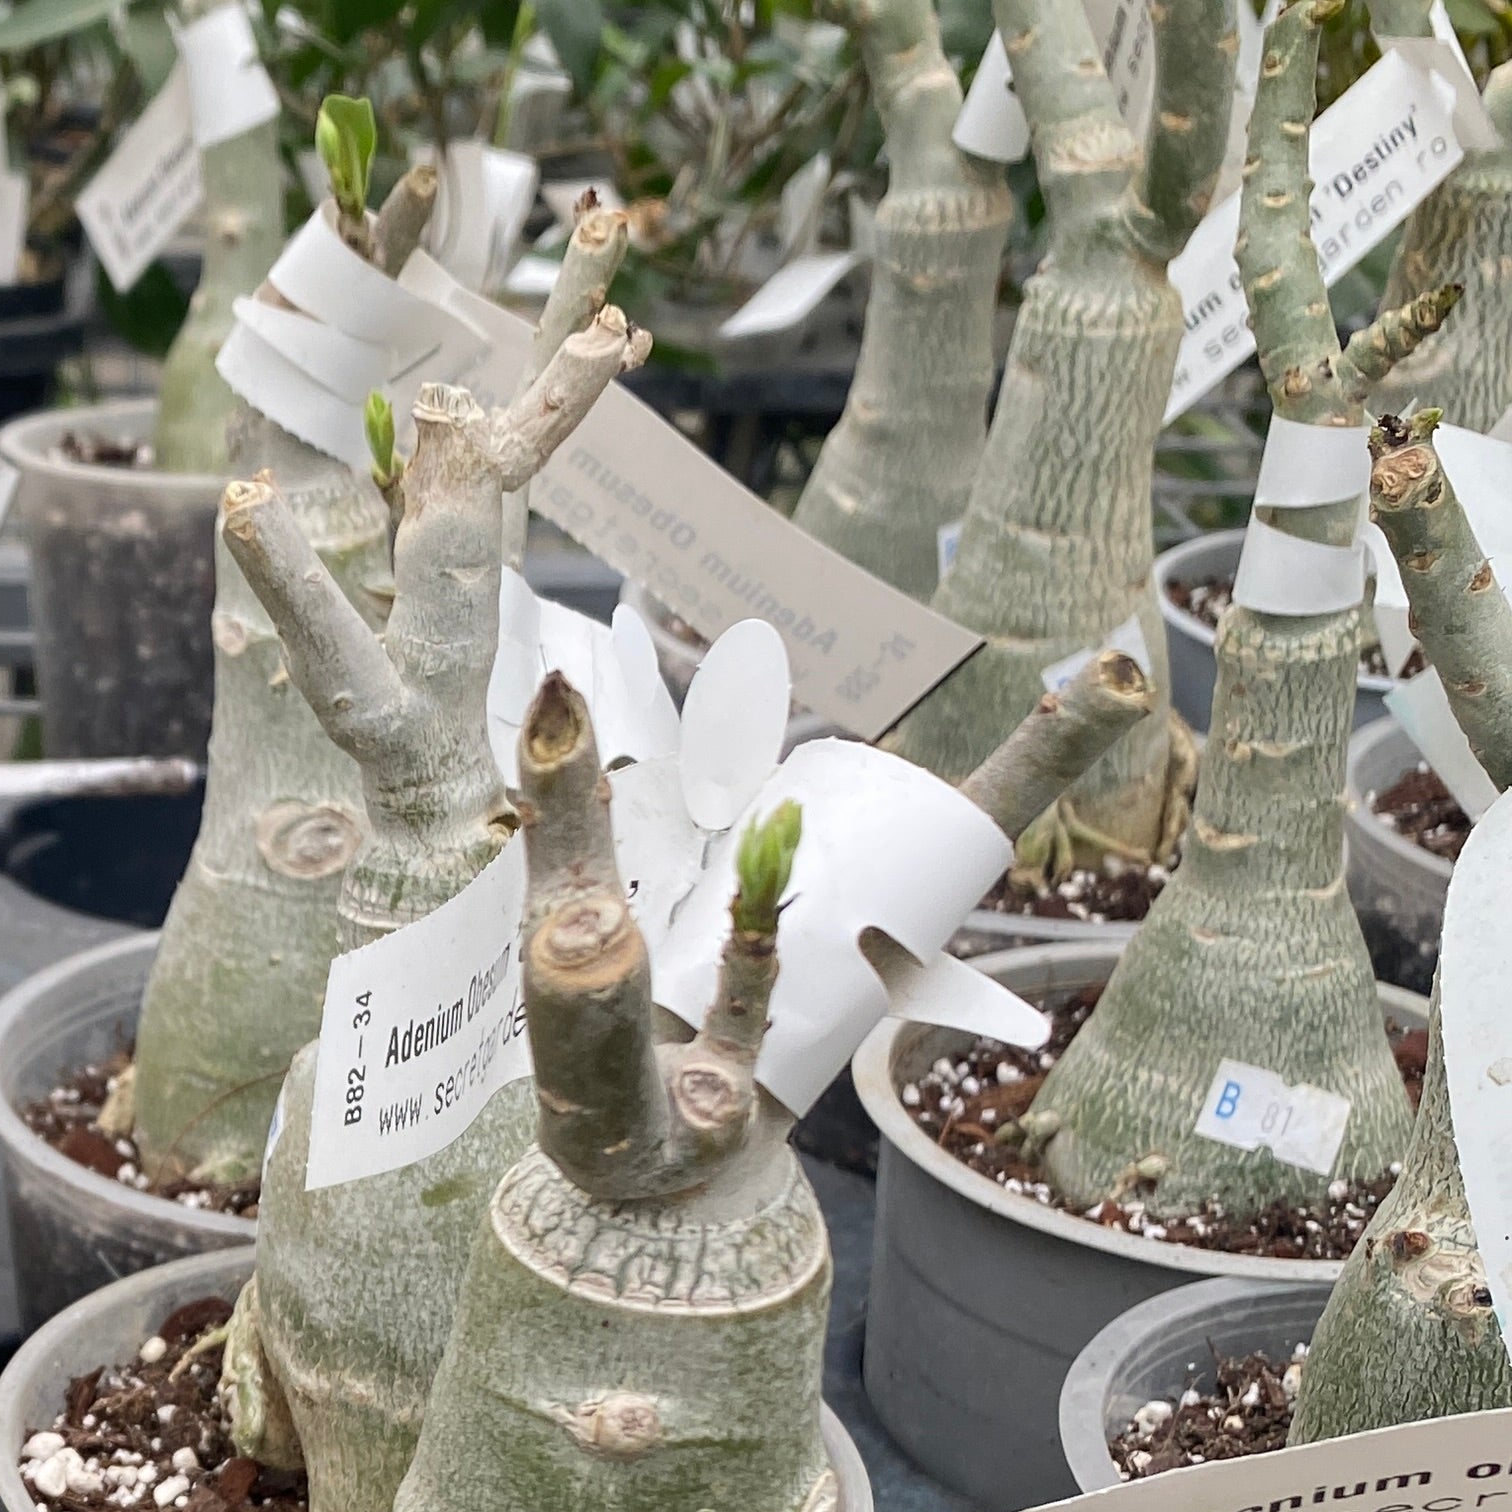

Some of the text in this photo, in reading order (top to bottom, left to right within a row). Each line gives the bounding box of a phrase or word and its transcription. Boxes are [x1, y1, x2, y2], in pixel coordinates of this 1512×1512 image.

[1323, 104, 1418, 198] 'Destiny'
[384, 996, 465, 1069] Adenium
[1214, 1079, 1243, 1119] B
